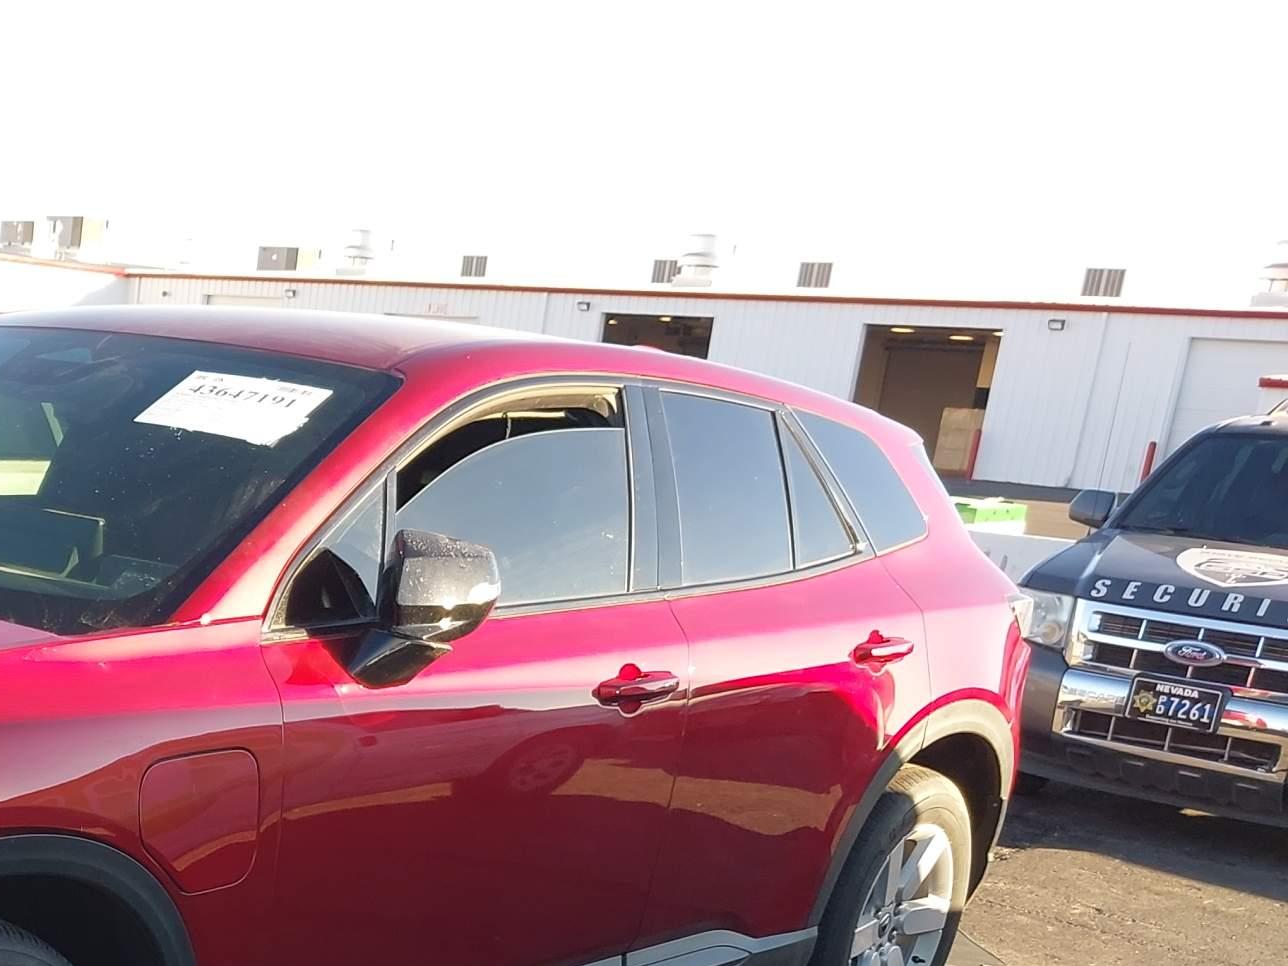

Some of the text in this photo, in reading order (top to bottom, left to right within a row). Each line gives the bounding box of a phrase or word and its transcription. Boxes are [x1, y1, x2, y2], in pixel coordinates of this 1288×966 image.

[188, 384, 297, 408] 43647191
[1090, 578, 1288, 623] SECURI
[1177, 645, 1207, 660] Ford
[1155, 682, 1199, 699] NEVADA
